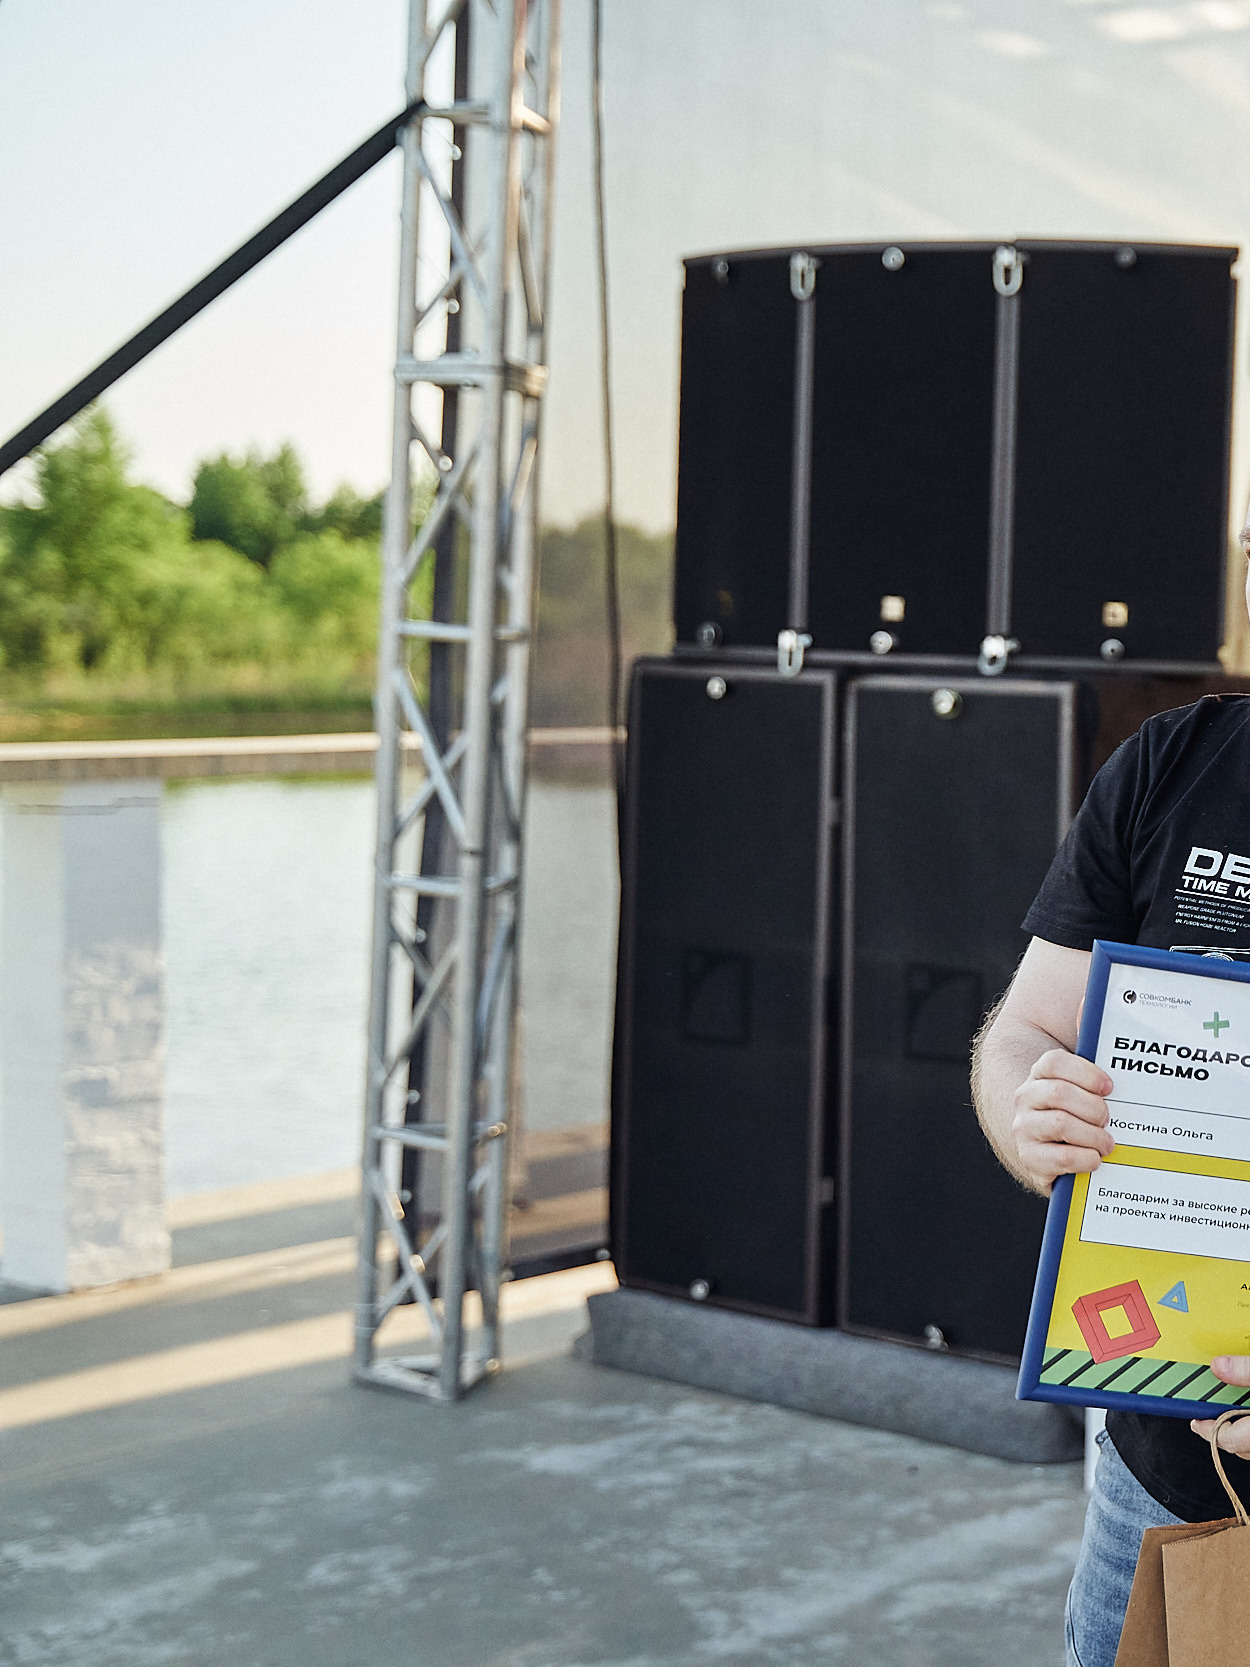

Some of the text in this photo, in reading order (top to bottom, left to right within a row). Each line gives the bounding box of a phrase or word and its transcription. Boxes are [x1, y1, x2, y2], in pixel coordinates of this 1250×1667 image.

[1180, 875, 1231, 895] TIME
[1139, 992, 1193, 1006] СОВКОМБАНК
[1110, 1056, 1210, 1081] ПИСЬМО
[1109, 1118, 1214, 1141] Костина Ольга
[1098, 1187, 1170, 1205] Благодарим
[1172, 1198, 1185, 1207] за
[1188, 1200, 1238, 1214] высокие
[1095, 1203, 1109, 1213] на
[1112, 1206, 1167, 1220] проектах
